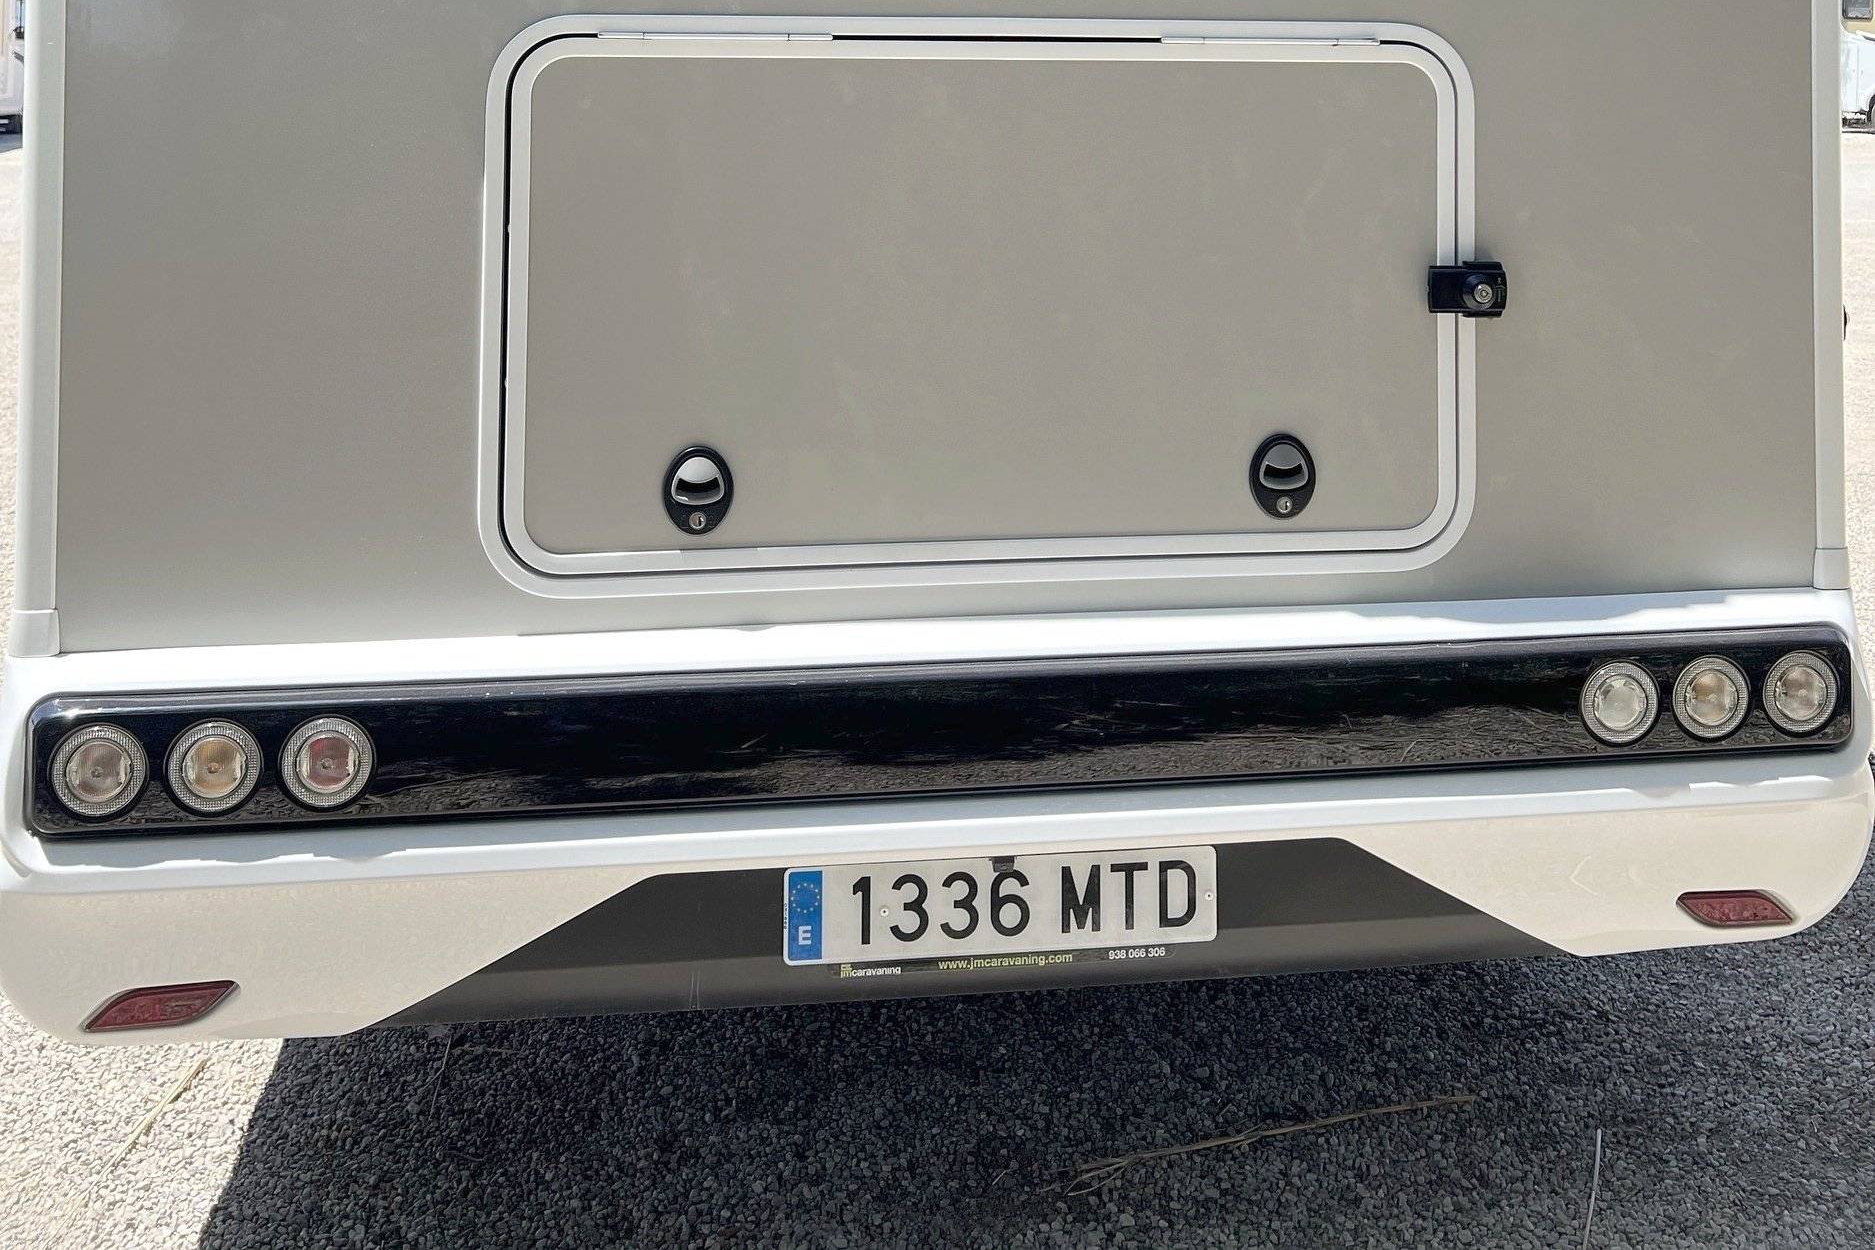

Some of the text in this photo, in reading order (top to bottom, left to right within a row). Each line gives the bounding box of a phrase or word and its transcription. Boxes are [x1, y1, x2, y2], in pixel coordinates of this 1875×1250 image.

[851, 859, 1197, 946] 1336 MTD
[798, 925, 812, 945] E
[840, 947, 1166, 979] jmcaravaning www.jmcaravaning.com 938 066 306
